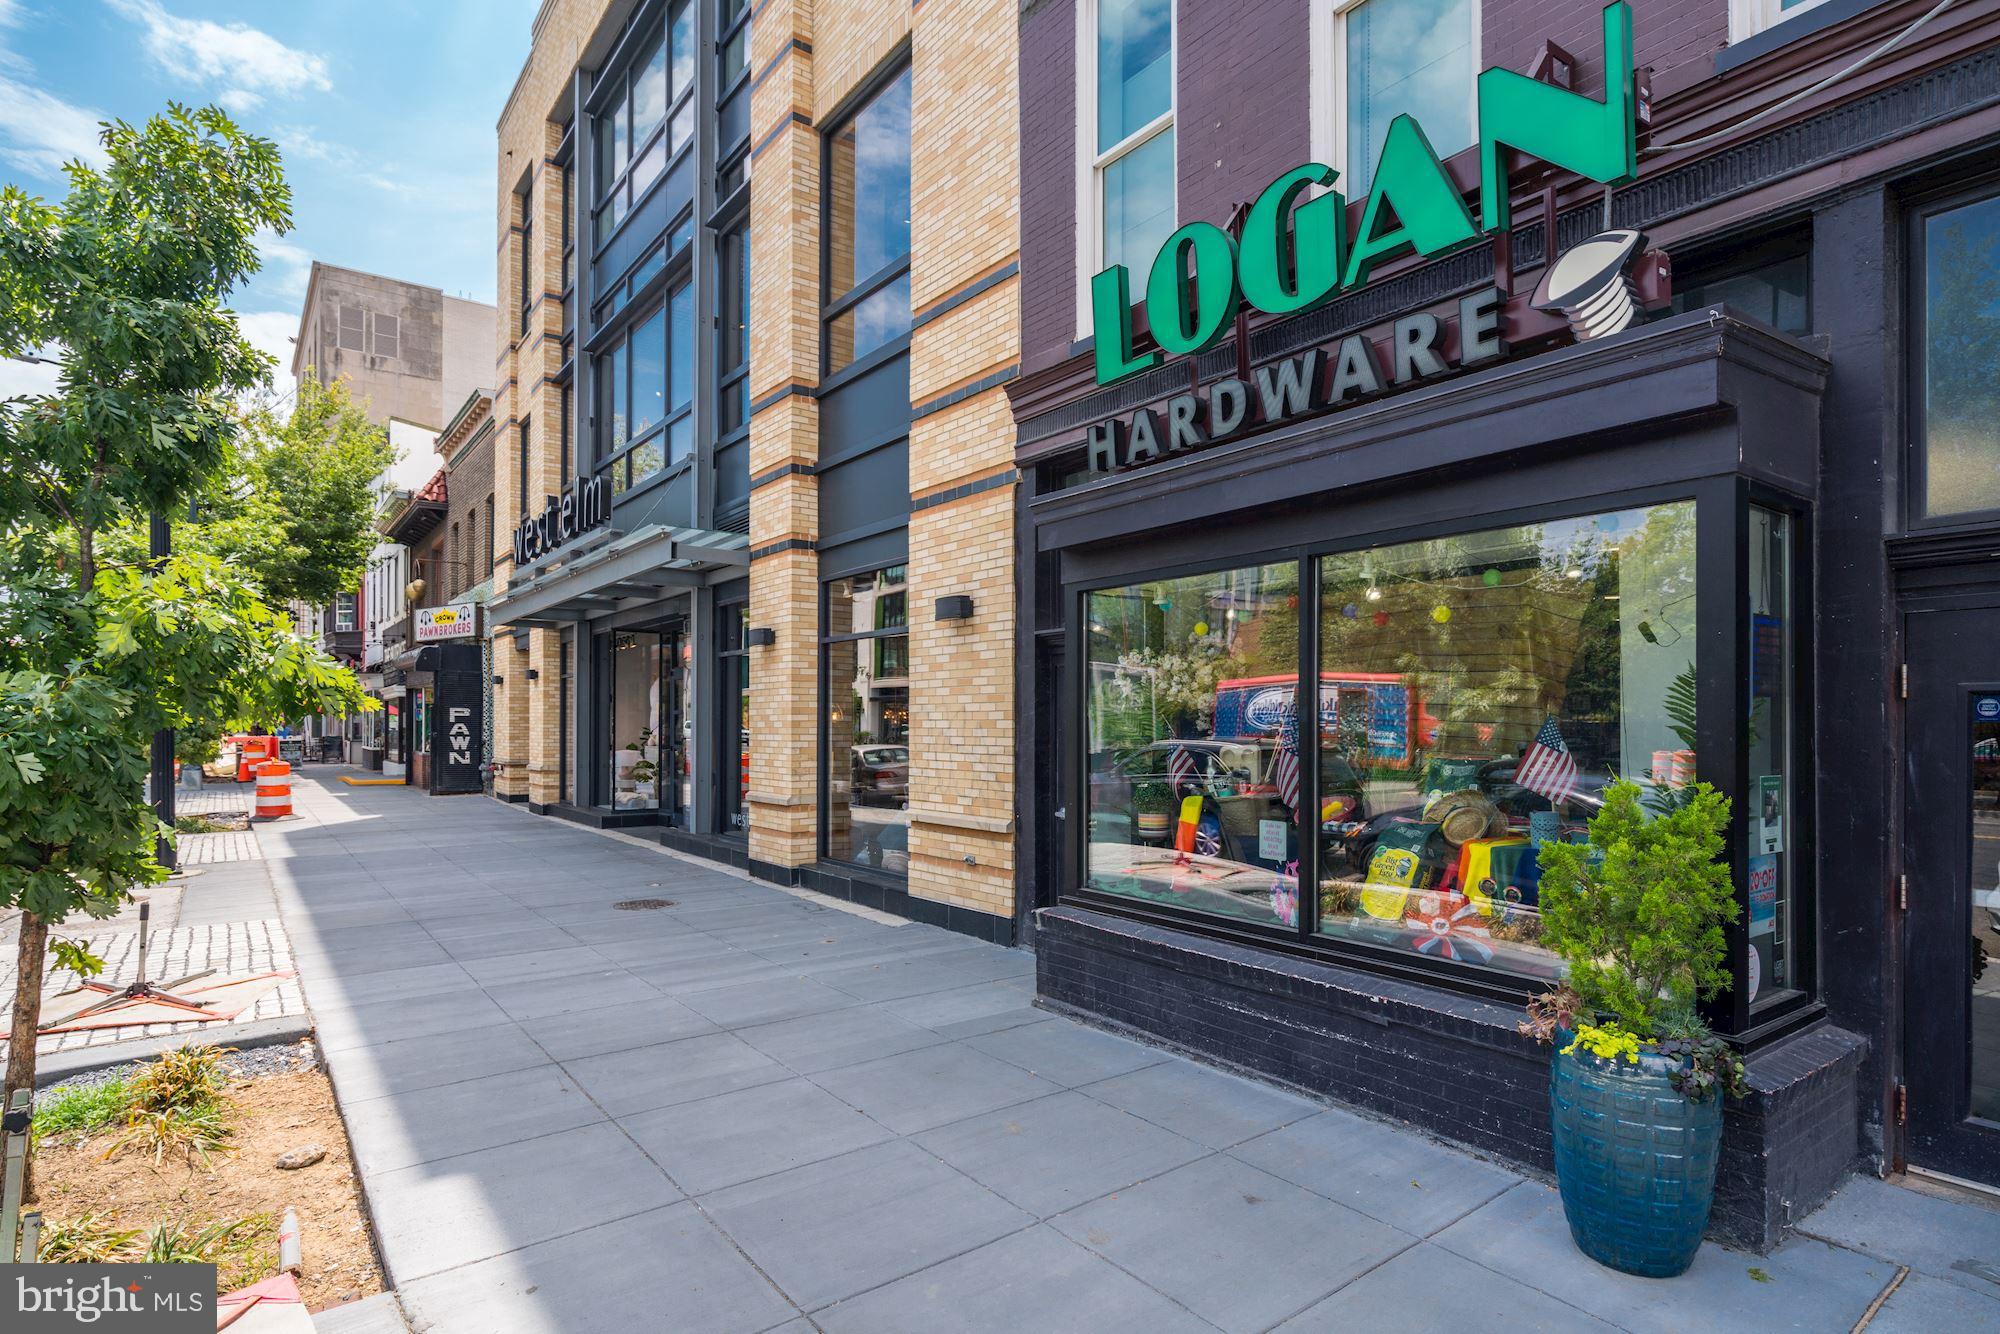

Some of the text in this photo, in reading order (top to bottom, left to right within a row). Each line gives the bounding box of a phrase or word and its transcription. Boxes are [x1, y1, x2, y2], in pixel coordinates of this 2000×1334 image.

[1092, 0, 1636, 386] LOGAN
[1087, 286, 1506, 473] HARDWARE
[514, 474, 602, 565] west elm
[419, 622, 471, 638] PAWNBROKERS
[434, 613, 455, 623] CROWN
[449, 707, 471, 765] PAWN
